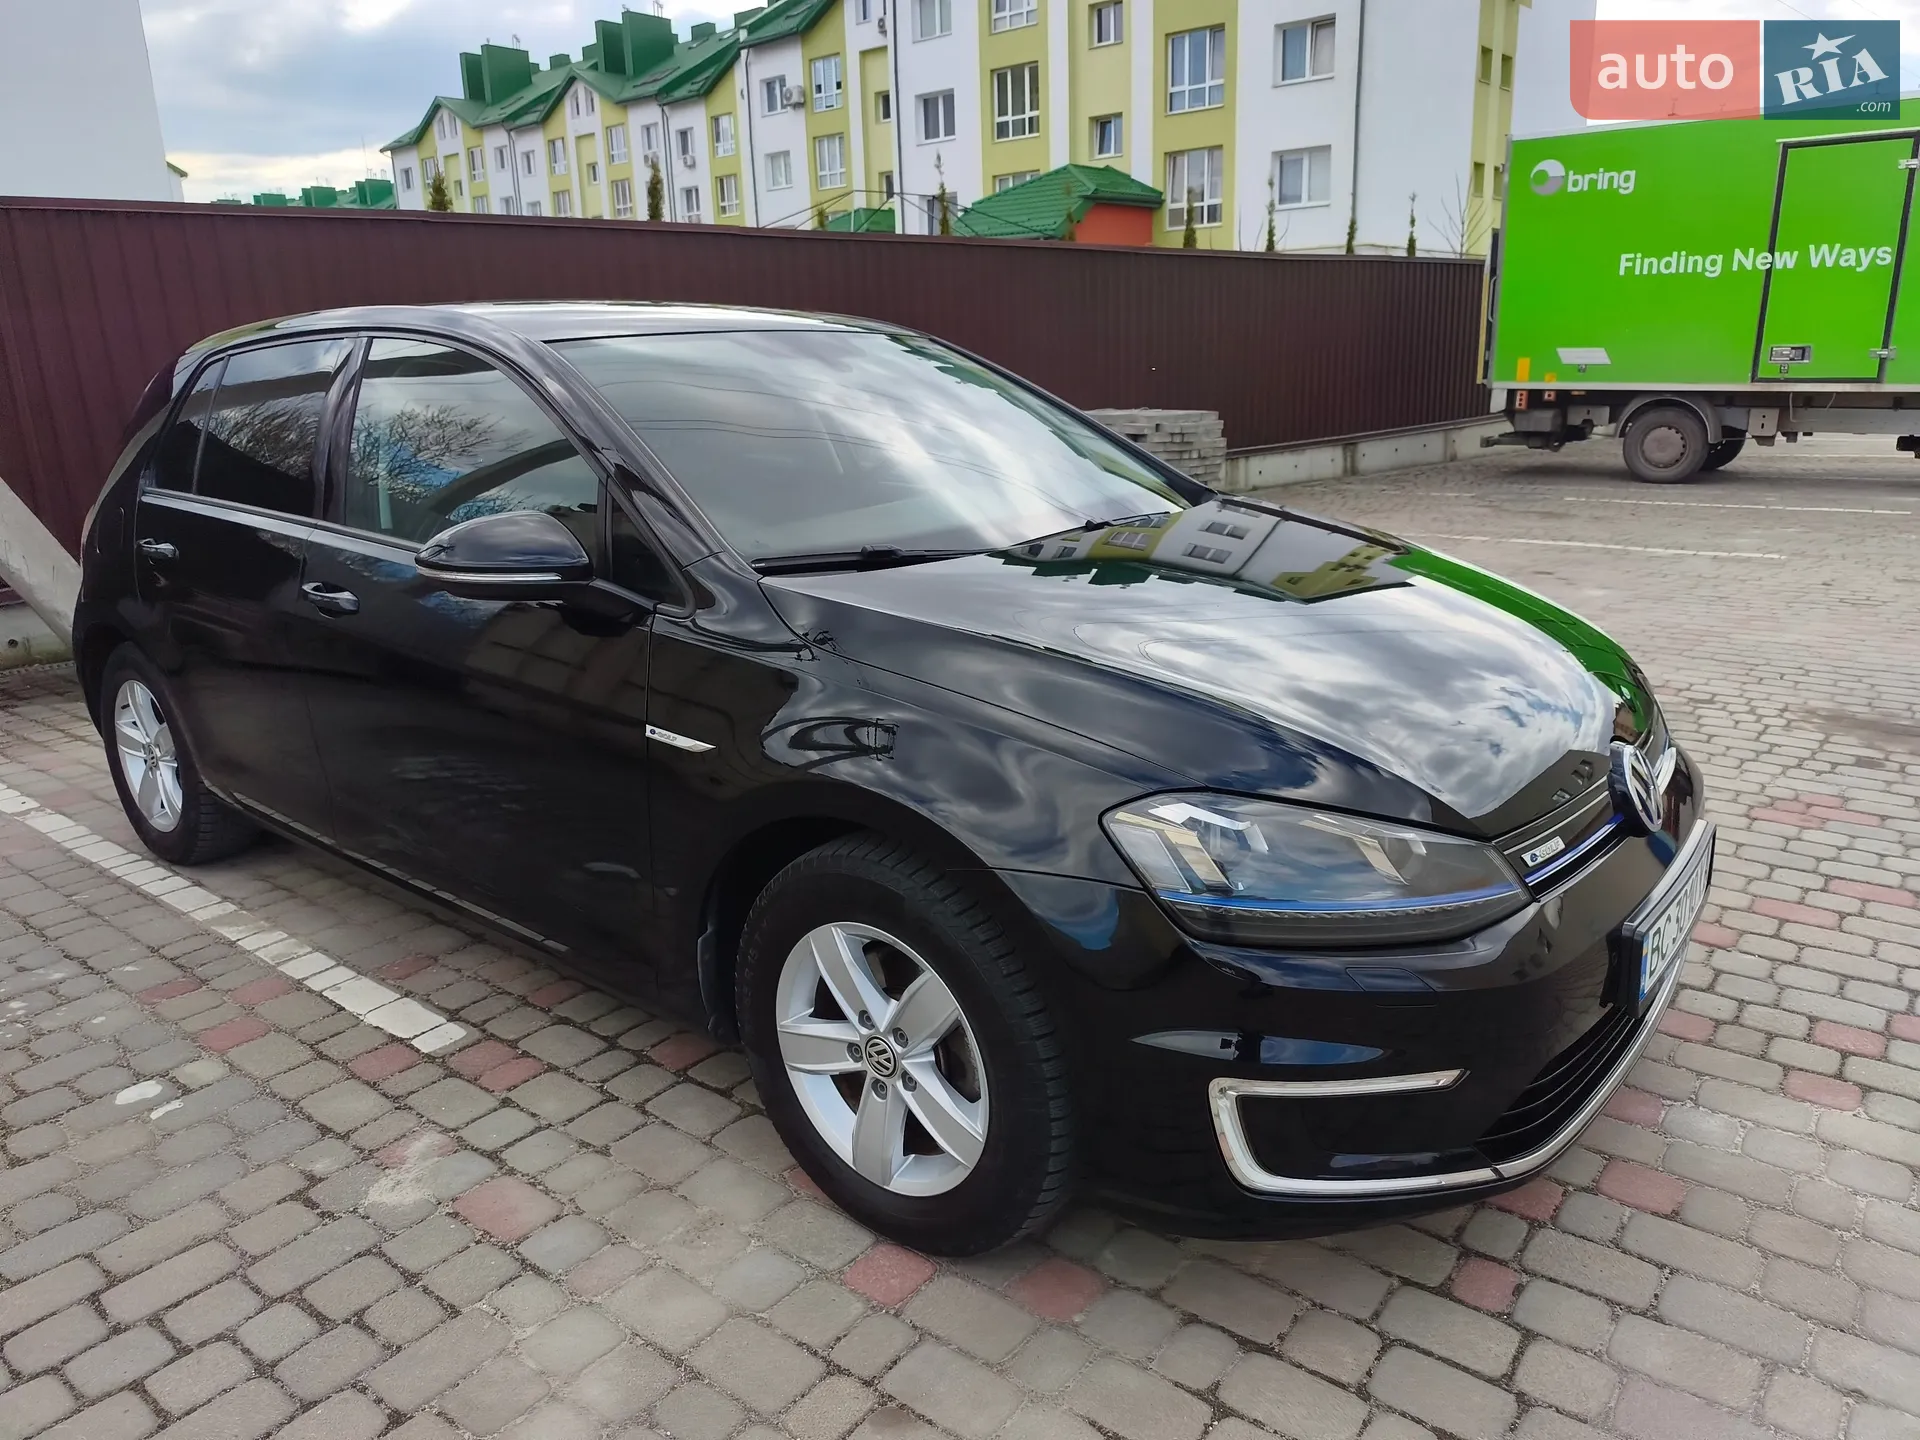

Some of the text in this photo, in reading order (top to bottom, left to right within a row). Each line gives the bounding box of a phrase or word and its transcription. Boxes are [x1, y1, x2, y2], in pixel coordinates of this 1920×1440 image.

[1567, 167, 1637, 195] bring
[1619, 244, 1893, 278] Finding New Ways
